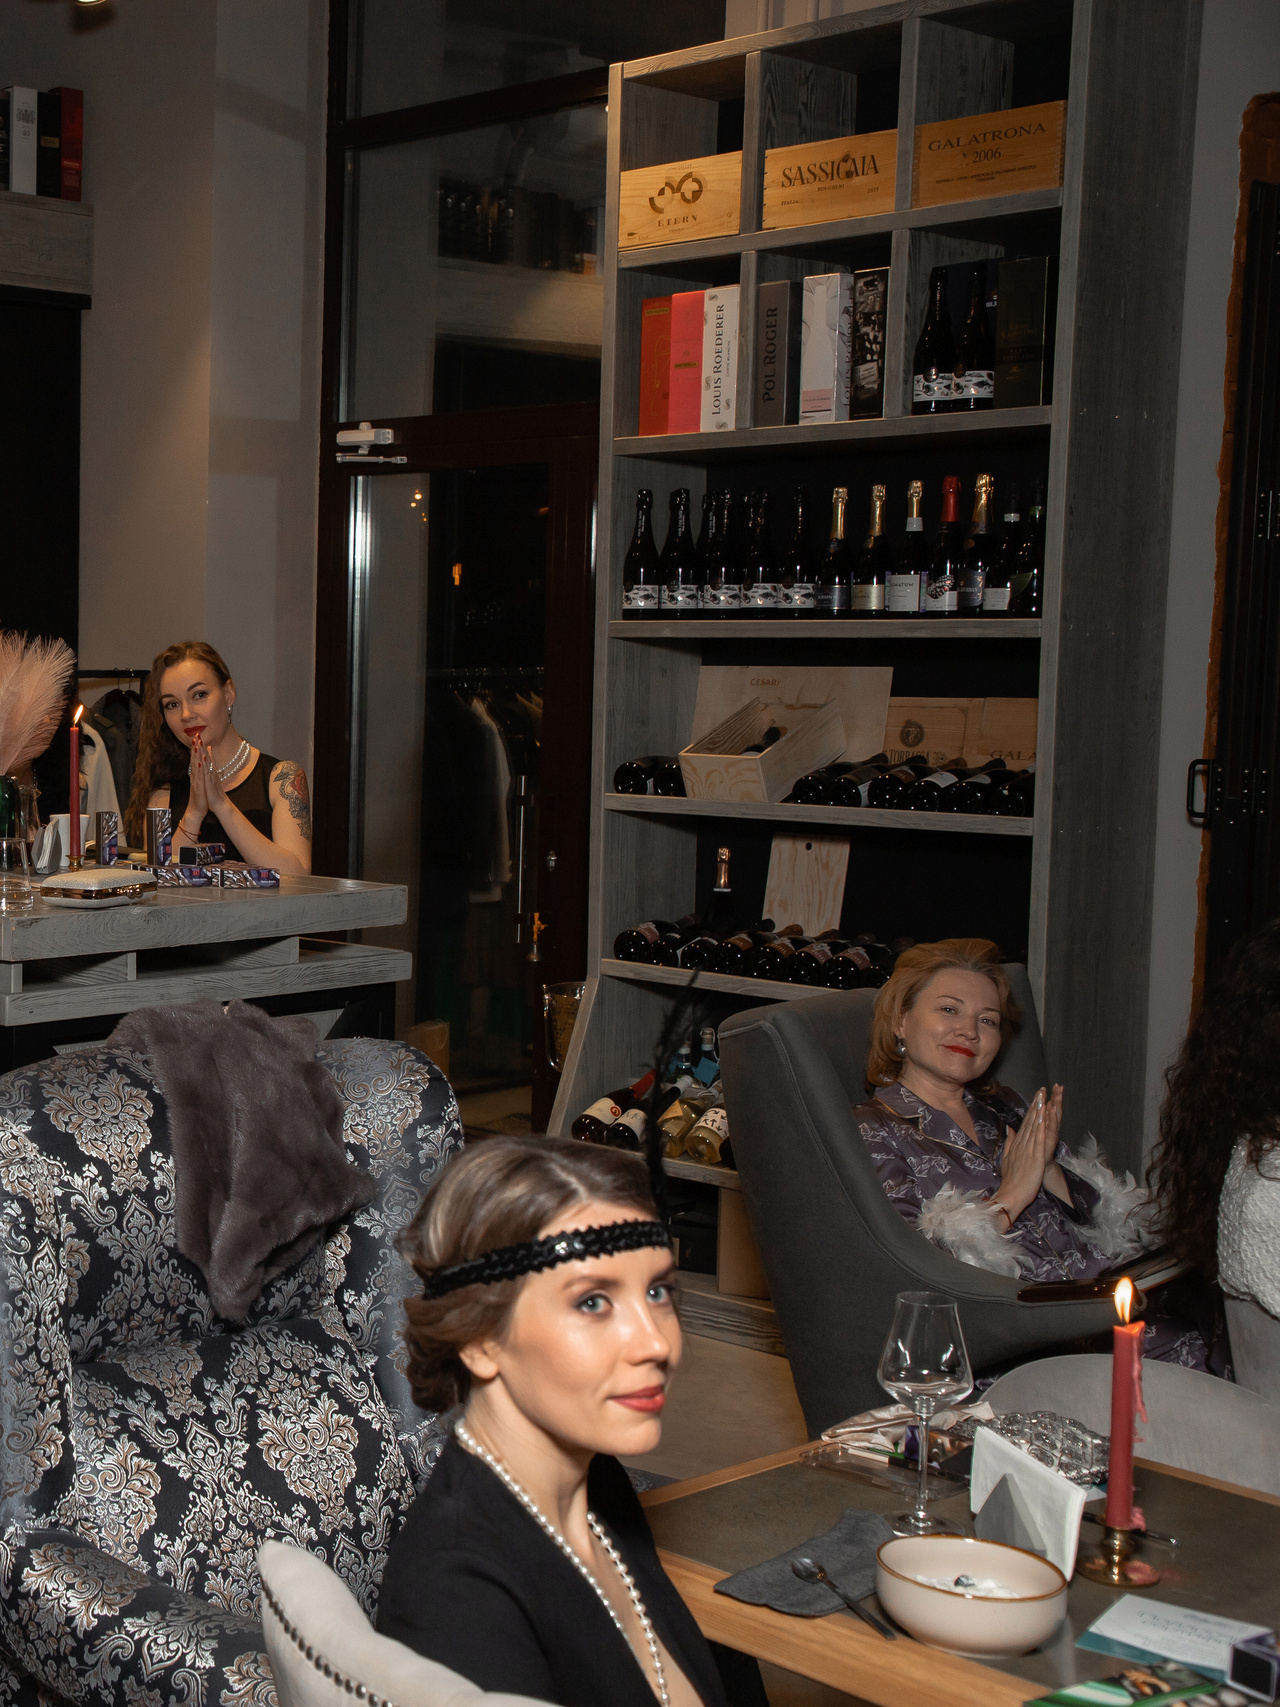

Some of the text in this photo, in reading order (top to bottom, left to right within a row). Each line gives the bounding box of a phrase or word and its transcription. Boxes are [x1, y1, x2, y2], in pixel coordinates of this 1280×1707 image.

[927, 123, 1047, 152] GALATRONA
[971, 147, 1002, 164] 2006
[781, 154, 880, 188] SASSICAIA
[657, 214, 699, 228] ETERN
[711, 304, 725, 416] LOUIS ROEDERER
[762, 306, 778, 403] POL ROGER
[750, 678, 780, 686] CESARI
